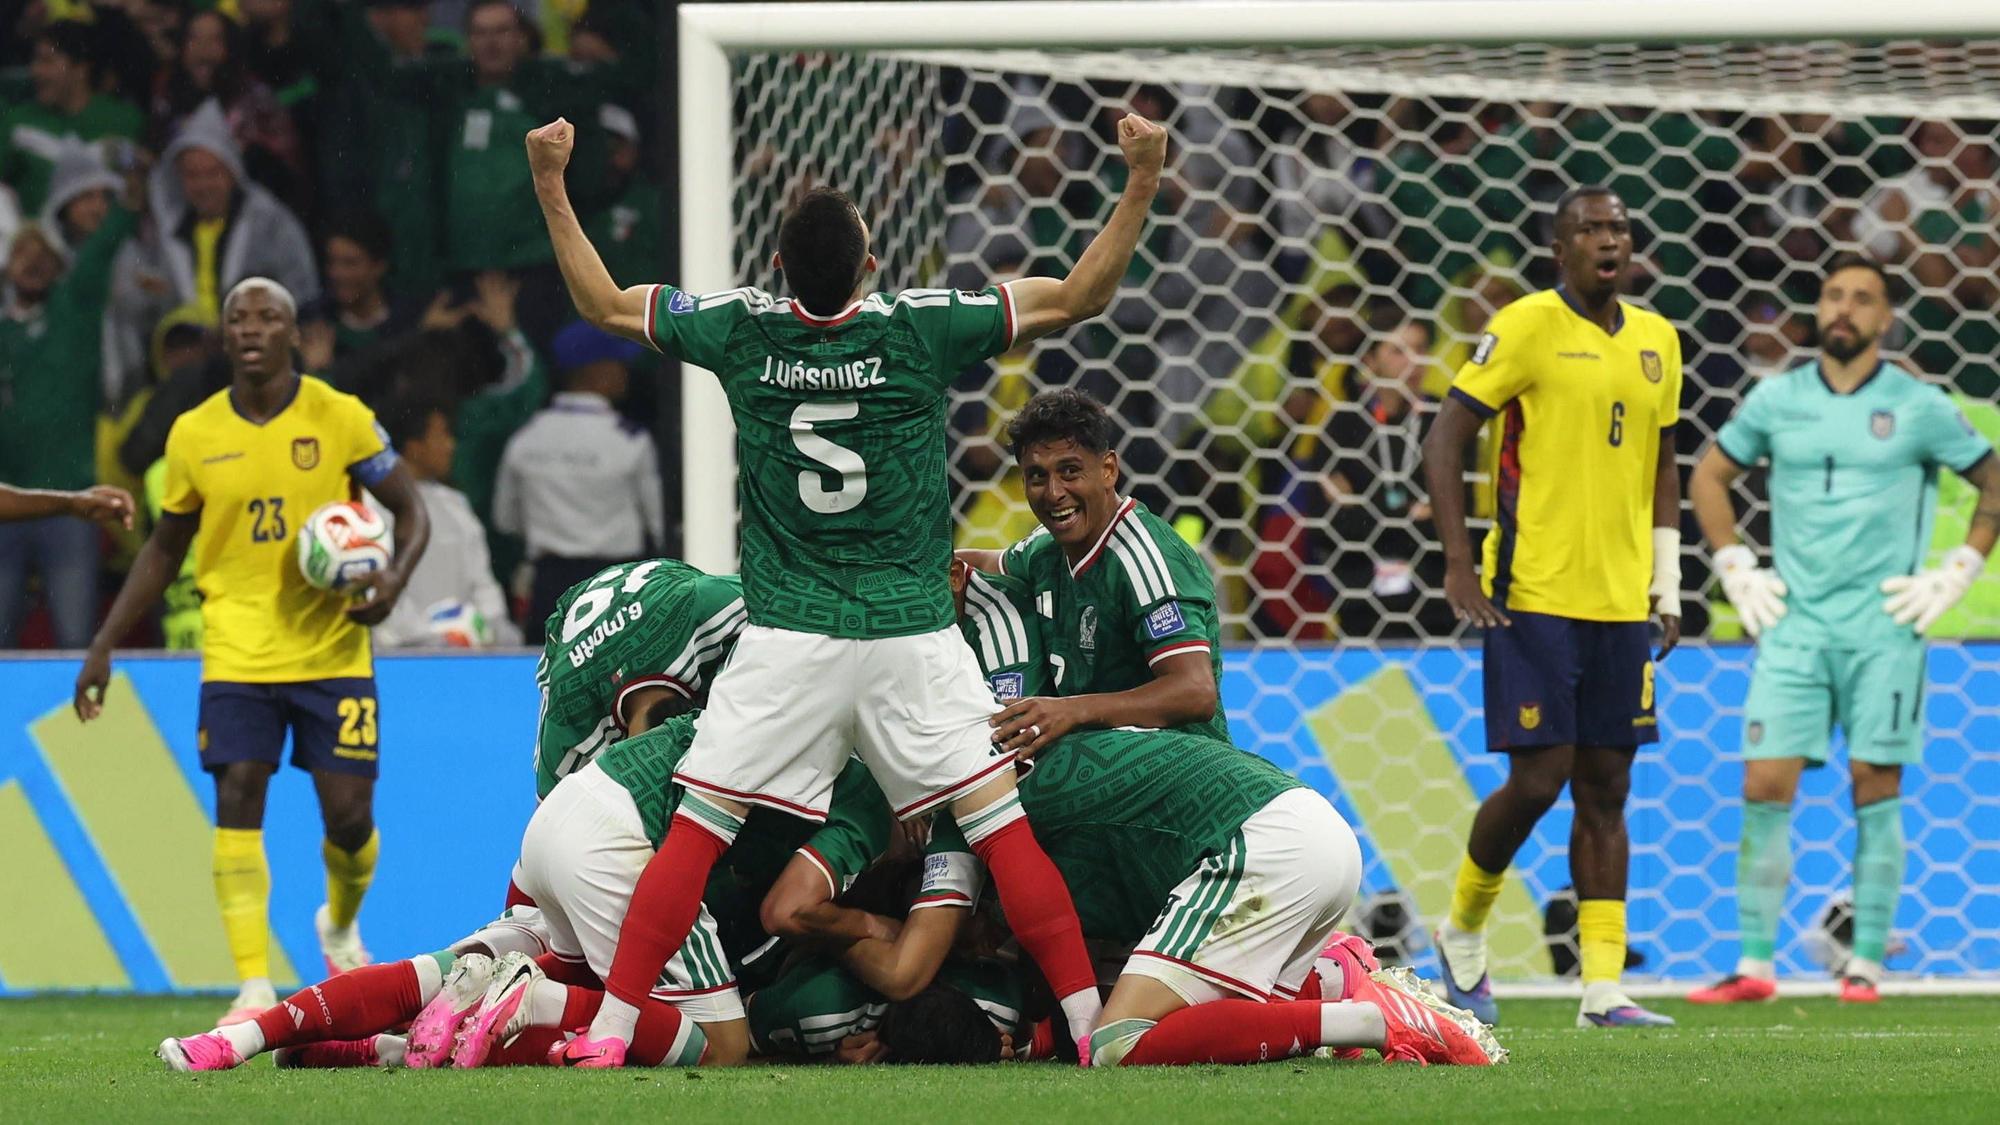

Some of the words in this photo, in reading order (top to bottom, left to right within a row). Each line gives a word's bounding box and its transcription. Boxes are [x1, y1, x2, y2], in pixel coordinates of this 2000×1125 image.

[759, 355, 886, 391] J.VÁSQUEZ
[1609, 401, 1625, 447] 6
[789, 401, 867, 514] 5
[1824, 454, 1834, 493] 1
[248, 497, 287, 543] 23
[569, 601, 643, 668] G.MORA
[1641, 661, 1654, 710] 6
[337, 696, 377, 747] 23
[1893, 691, 1902, 731] 1
